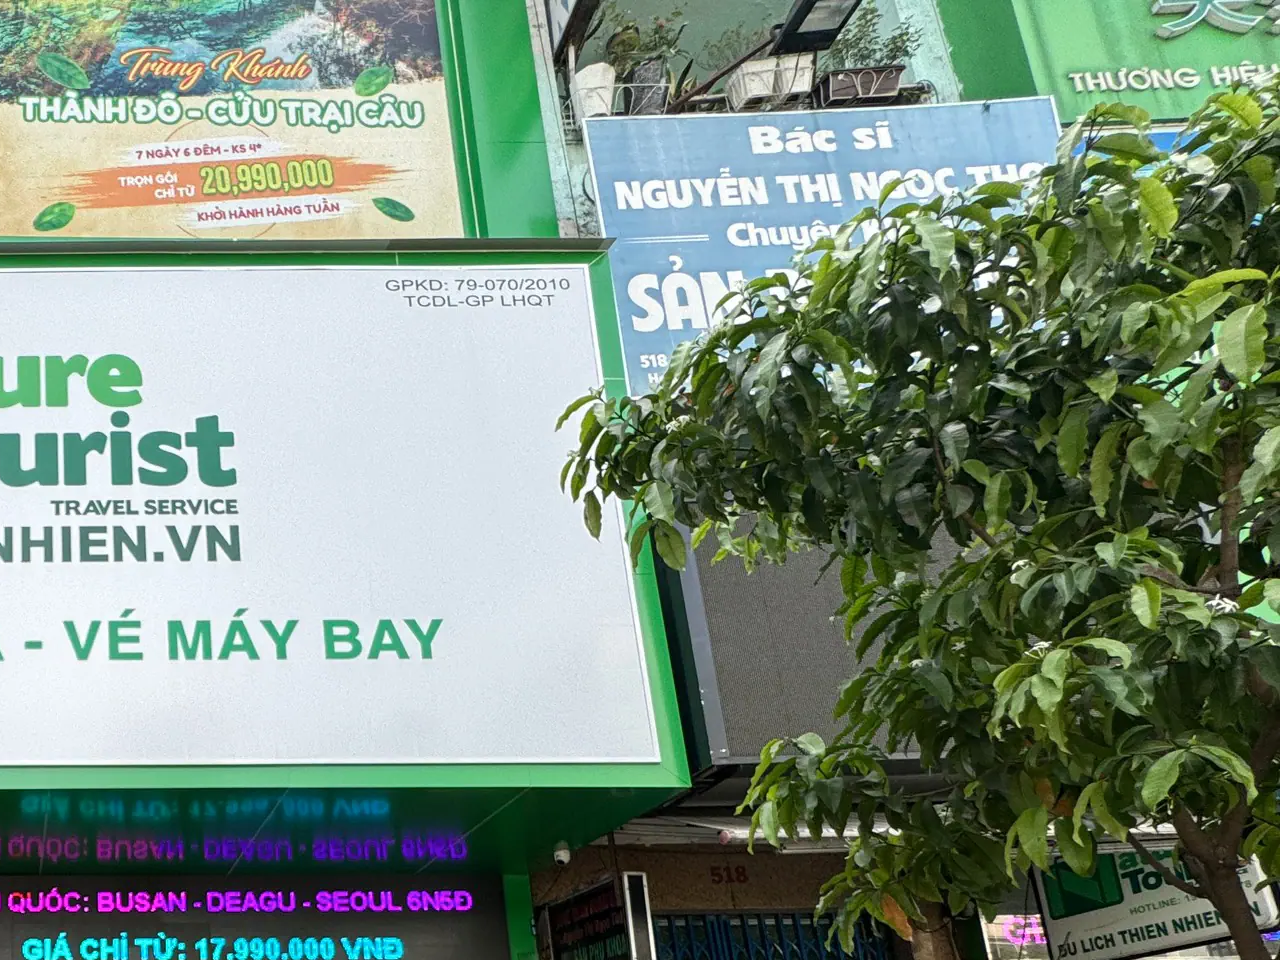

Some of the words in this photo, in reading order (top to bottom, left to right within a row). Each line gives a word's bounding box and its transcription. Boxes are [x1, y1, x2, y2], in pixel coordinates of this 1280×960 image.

[120, 46, 206, 90] Trùng
[211, 48, 312, 84] Khánh
[1069, 67, 1201, 92] THƯƠNG
[21, 91, 127, 125] THÀNH
[132, 91, 182, 126] ĐÔ
[206, 92, 276, 127] CỬU
[279, 100, 354, 133] TRẠI
[356, 93, 426, 128] CÂU
[747, 126, 837, 155] Bác
[852, 120, 894, 151] sĩ
[136, 149, 143, 160] 7
[145, 146, 181, 159] NGÀY
[183, 147, 191, 158] 6
[193, 143, 221, 157] ĐÊM
[231, 144, 247, 155] KS
[117, 173, 153, 189] TRỌN
[199, 159, 334, 198] 20,990,000
[613, 167, 769, 211] NGUYỄN
[775, 172, 845, 208] THỊ
[154, 185, 176, 200] CHỈ
[177, 183, 196, 198] TỪ
[197, 206, 226, 223] KHỞI
[228, 203, 265, 220] HÀNH
[266, 200, 303, 219] HÀNG
[304, 196, 340, 216] TUẦN
[384, 278, 449, 292] GPKD:
[453, 277, 571, 293] 79-070/2010
[402, 294, 498, 308] TCDL-GP
[502, 294, 556, 309] LHQT
[639, 353, 668, 369] 518
[50, 500, 139, 515] TRAVEL
[144, 499, 239, 515] SERVICE
[64, 608, 144, 662] VÉ
[166, 607, 299, 660] MÁY
[322, 618, 444, 660] BAY
[710, 866, 749, 884] 518
[7, 889, 89, 915] QUỐC:
[97, 891, 187, 912] BUSAN
[207, 891, 296, 912] DEAGU
[316, 891, 402, 912] SEOUL
[1129, 897, 1182, 915] HOTLINE:
[134, 932, 186, 960] TỪ:
[195, 937, 335, 960] 17.990.000
[343, 937, 404, 960] VNĐ
[1080, 933, 1117, 954] LICH
[1120, 921, 1169, 946] THIEN
